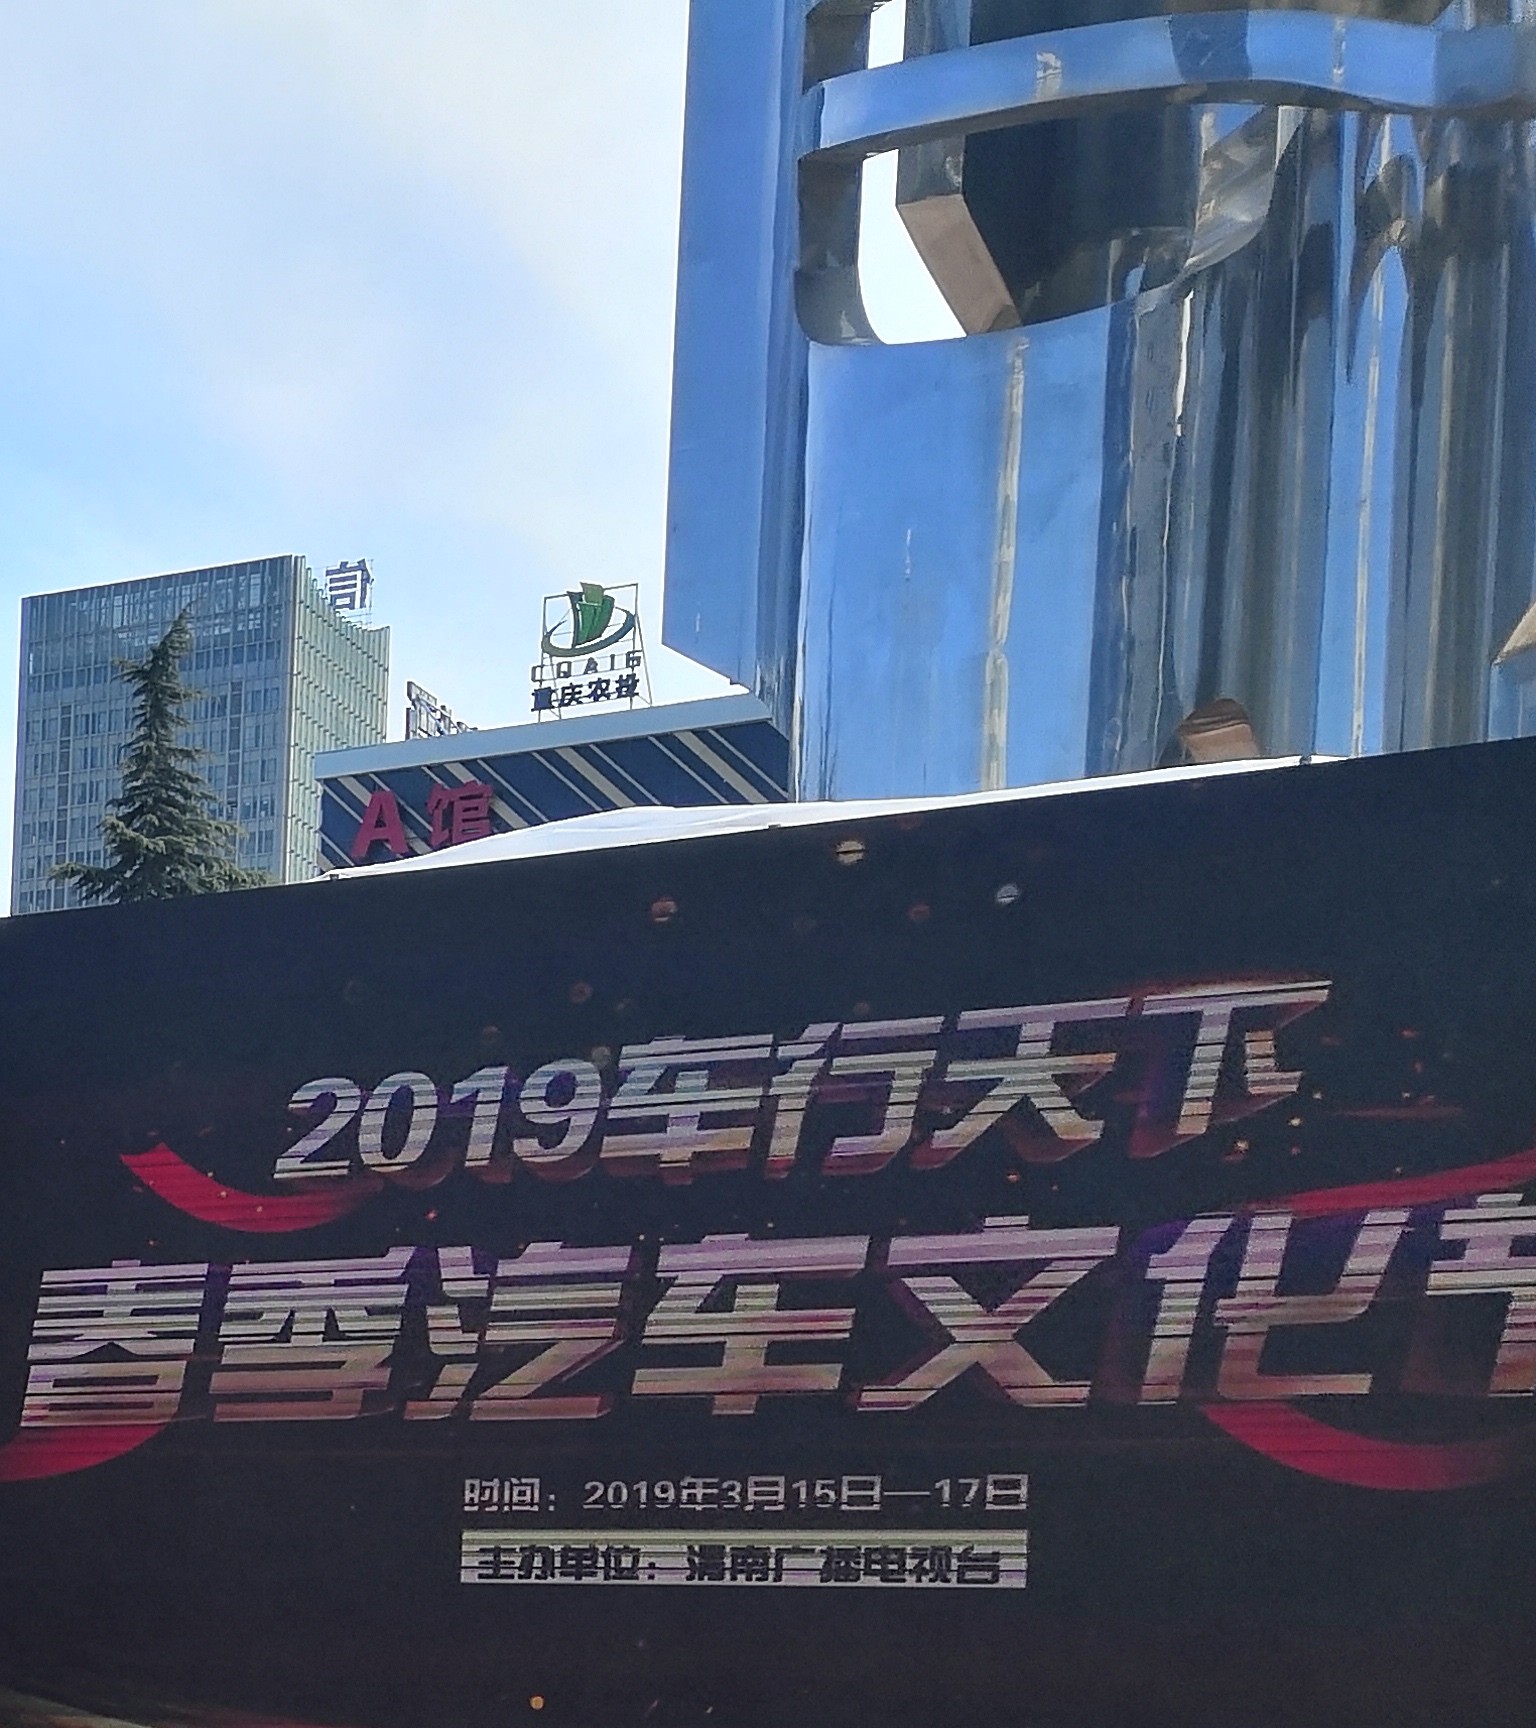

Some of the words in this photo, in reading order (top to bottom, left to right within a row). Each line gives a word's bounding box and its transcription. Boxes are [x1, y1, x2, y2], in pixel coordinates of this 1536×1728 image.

[531, 650, 642, 682] CQAIG
[531, 673, 639, 712] 重庆农投
[273, 980, 1332, 1180] 2019车行天下
